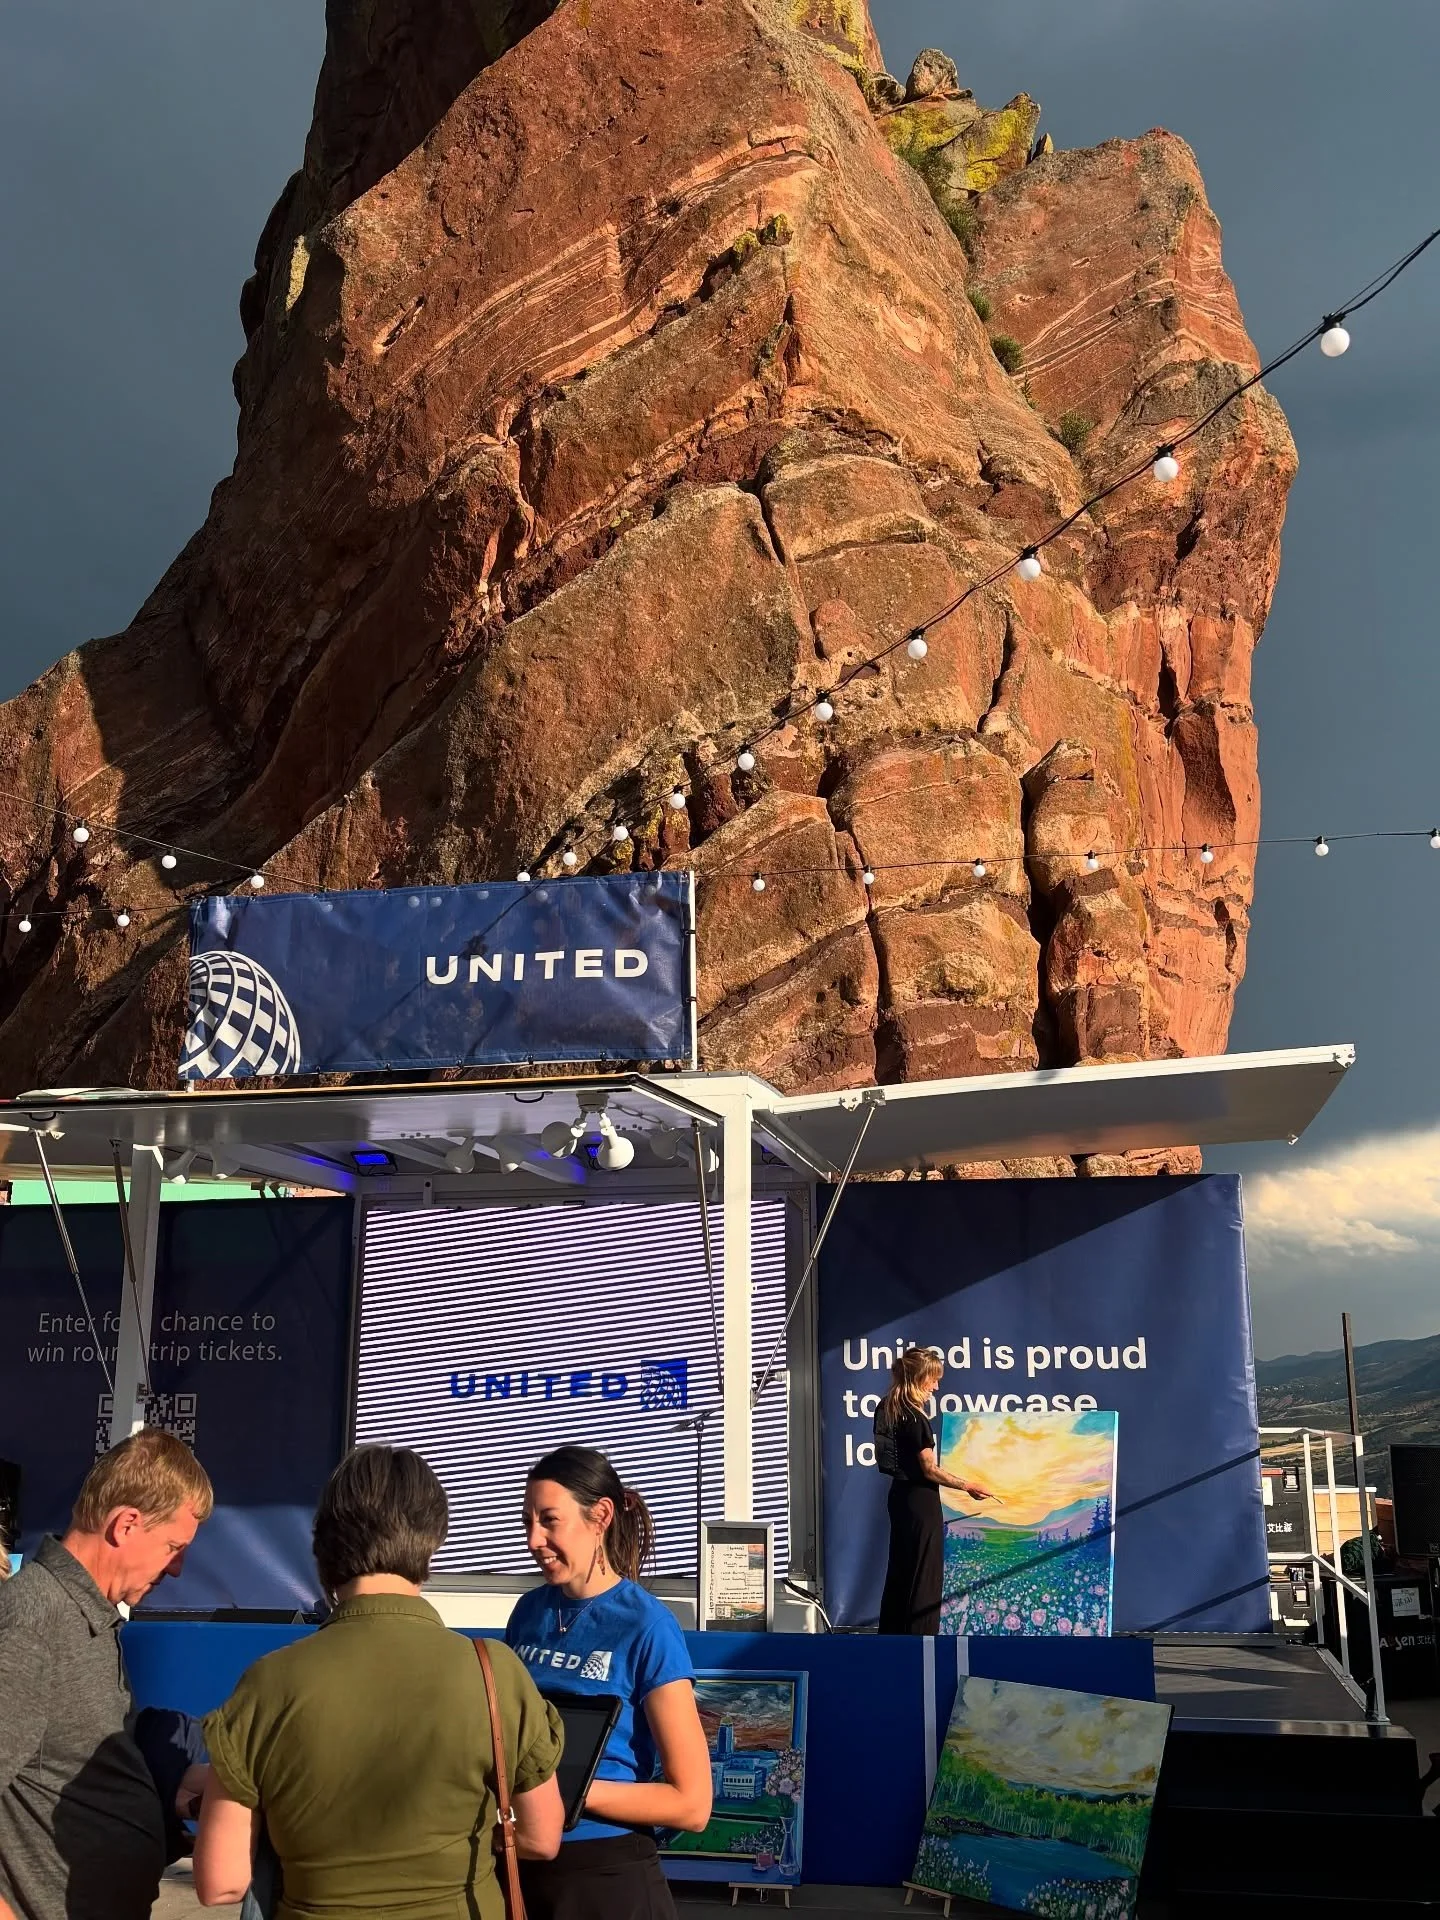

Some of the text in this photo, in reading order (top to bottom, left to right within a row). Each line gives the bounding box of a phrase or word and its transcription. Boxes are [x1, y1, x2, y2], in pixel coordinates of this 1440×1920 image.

[426, 949, 649, 985] UNITED
[39, 1311, 276, 1333] Enter fo chance to
[28, 1342, 65, 1362] win
[199, 1340, 283, 1361] tickets.
[843, 1336, 1147, 1377] Unid is proud
[451, 1370, 629, 1400] UNITED
[843, 1390, 881, 1418] to
